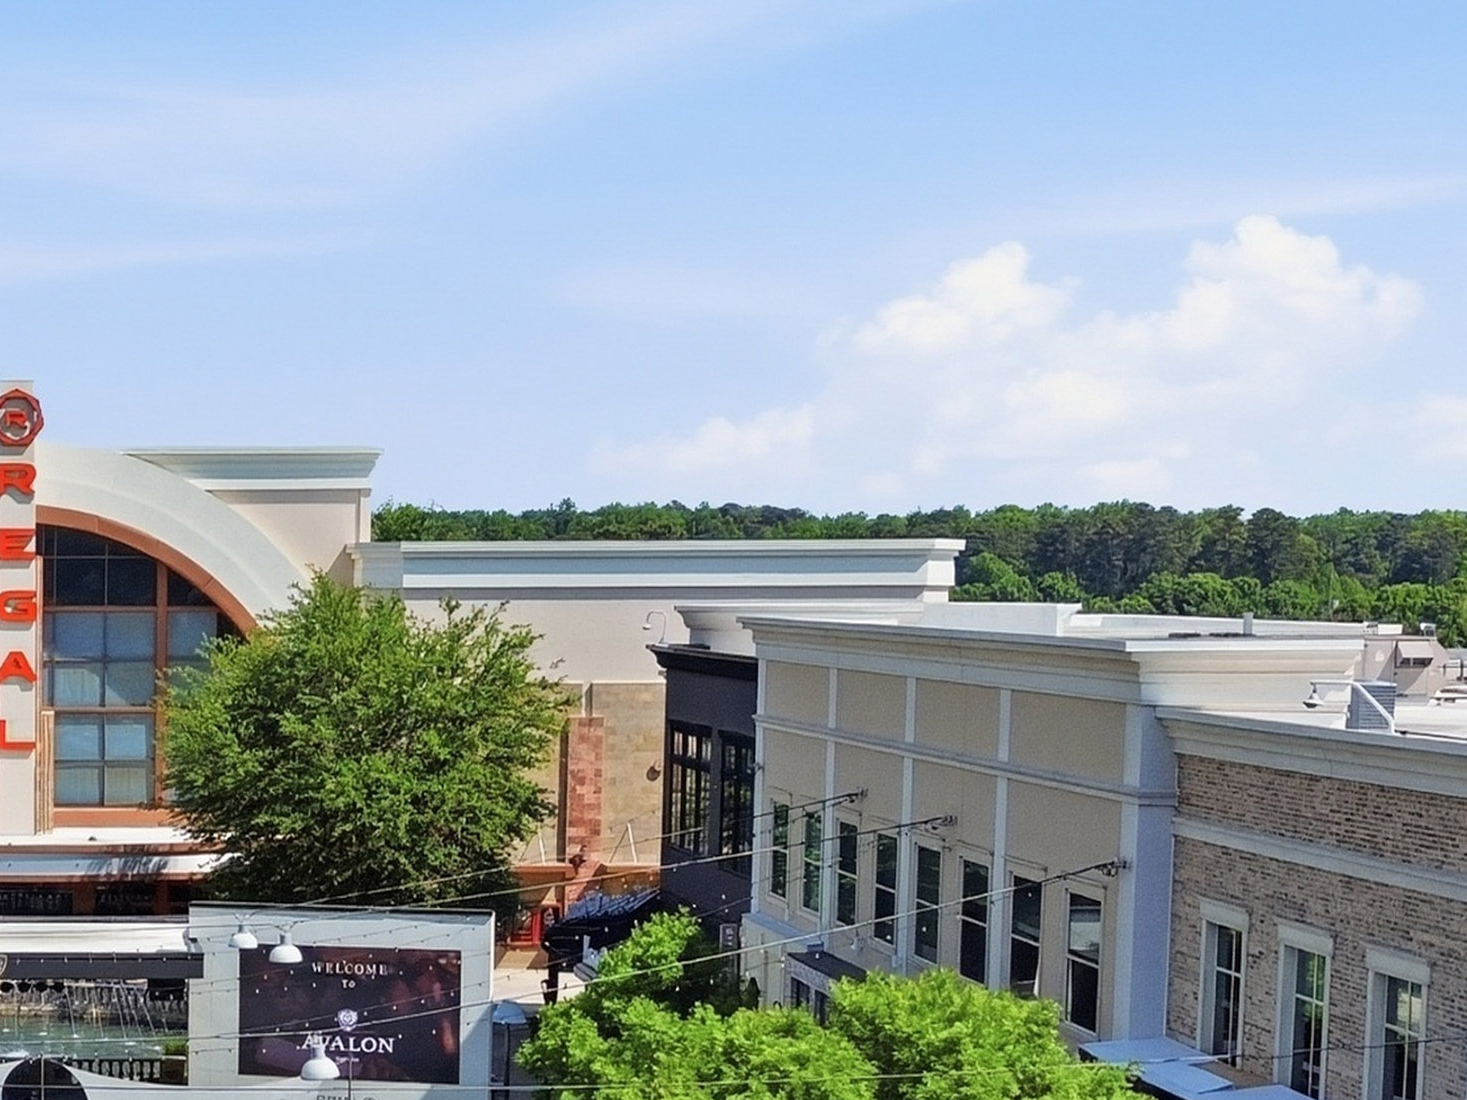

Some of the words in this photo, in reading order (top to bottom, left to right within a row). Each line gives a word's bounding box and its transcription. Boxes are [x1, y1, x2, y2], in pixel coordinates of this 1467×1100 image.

[311, 962, 388, 976] WELCOME
[341, 979, 356, 989] TO
[301, 1033, 395, 1054] AVALON
